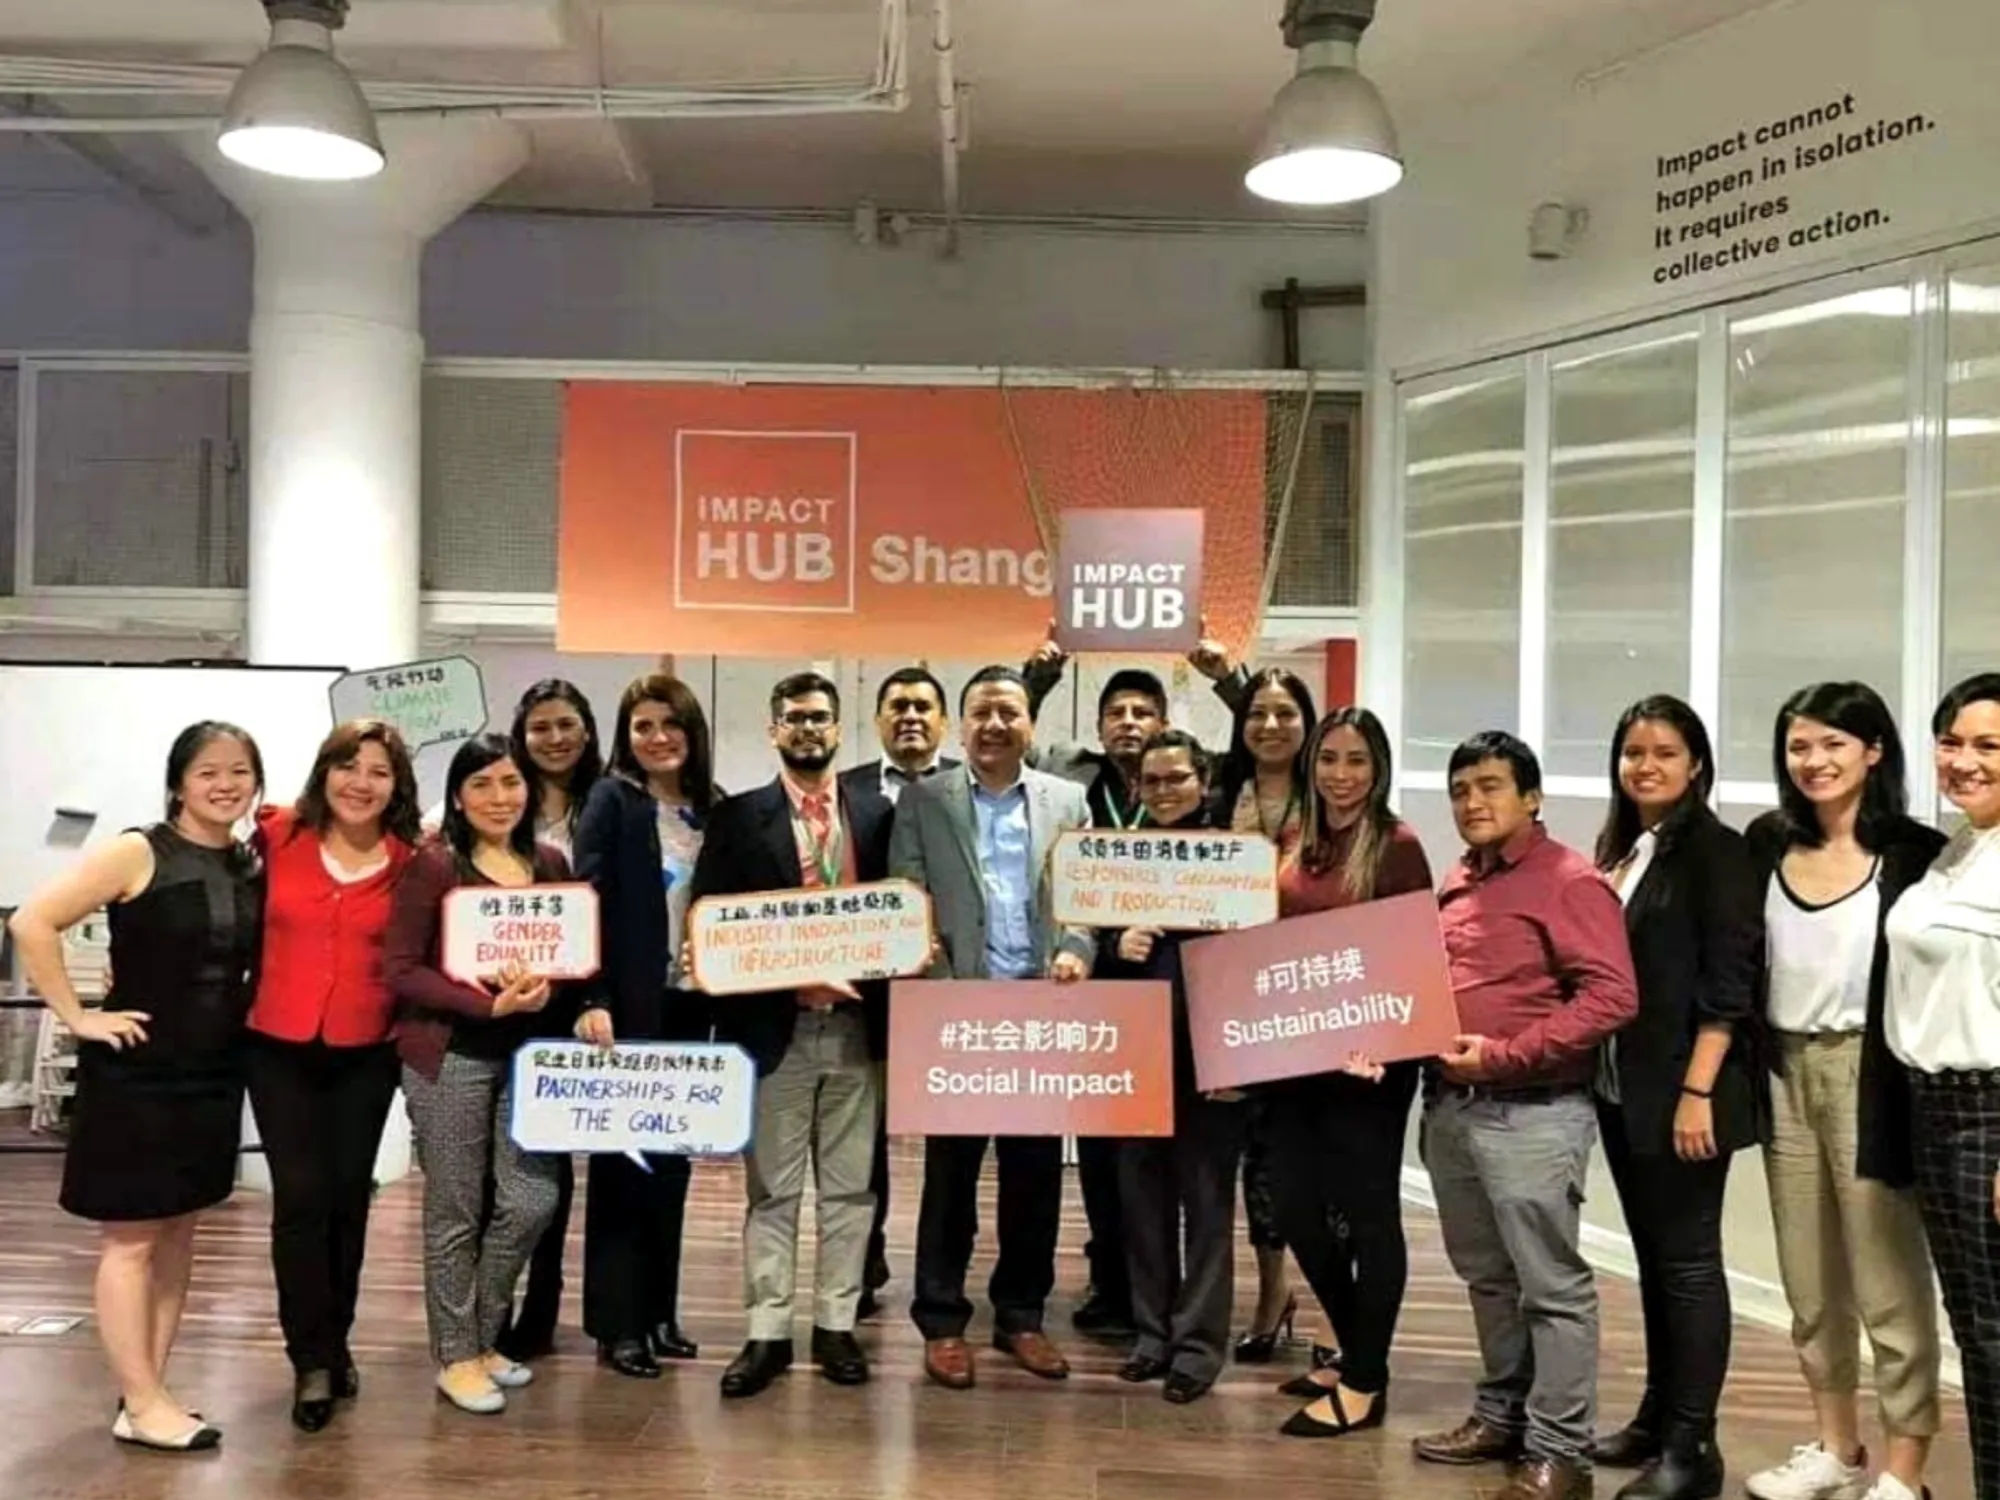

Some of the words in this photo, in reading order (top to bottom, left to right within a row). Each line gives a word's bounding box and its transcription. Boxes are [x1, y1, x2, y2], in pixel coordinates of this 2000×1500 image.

[1657, 131, 1747, 178] Impact
[1755, 93, 1856, 146] cannot
[1656, 168, 1753, 213] happen
[1761, 156, 1786, 182] in
[1795, 113, 1935, 170] isolation.
[1655, 226, 1672, 249] It
[1679, 195, 1790, 243] requires
[1653, 233, 1780, 284] collective
[1788, 207, 1890, 247] action.
[698, 496, 835, 524] IMPACT
[698, 531, 835, 582] HUB
[870, 535, 1054, 597] Shang
[1072, 564, 1186, 584] IMPACT
[1071, 588, 1185, 629] HUB
[1112, 889, 1215, 913] PRODUCTION
[493, 922, 565, 942] GENDER
[1253, 947, 1366, 997] #可持续
[939, 1020, 1118, 1053] #社会影响力
[1223, 992, 1414, 1048] Sustainability
[535, 1074, 675, 1101] PARTNERSHIPS
[686, 1086, 723, 1106] FOR
[927, 1067, 1018, 1095] Social
[1029, 1067, 1134, 1100] Impact
[570, 1107, 612, 1131] THE
[628, 1110, 689, 1135] GOALS
